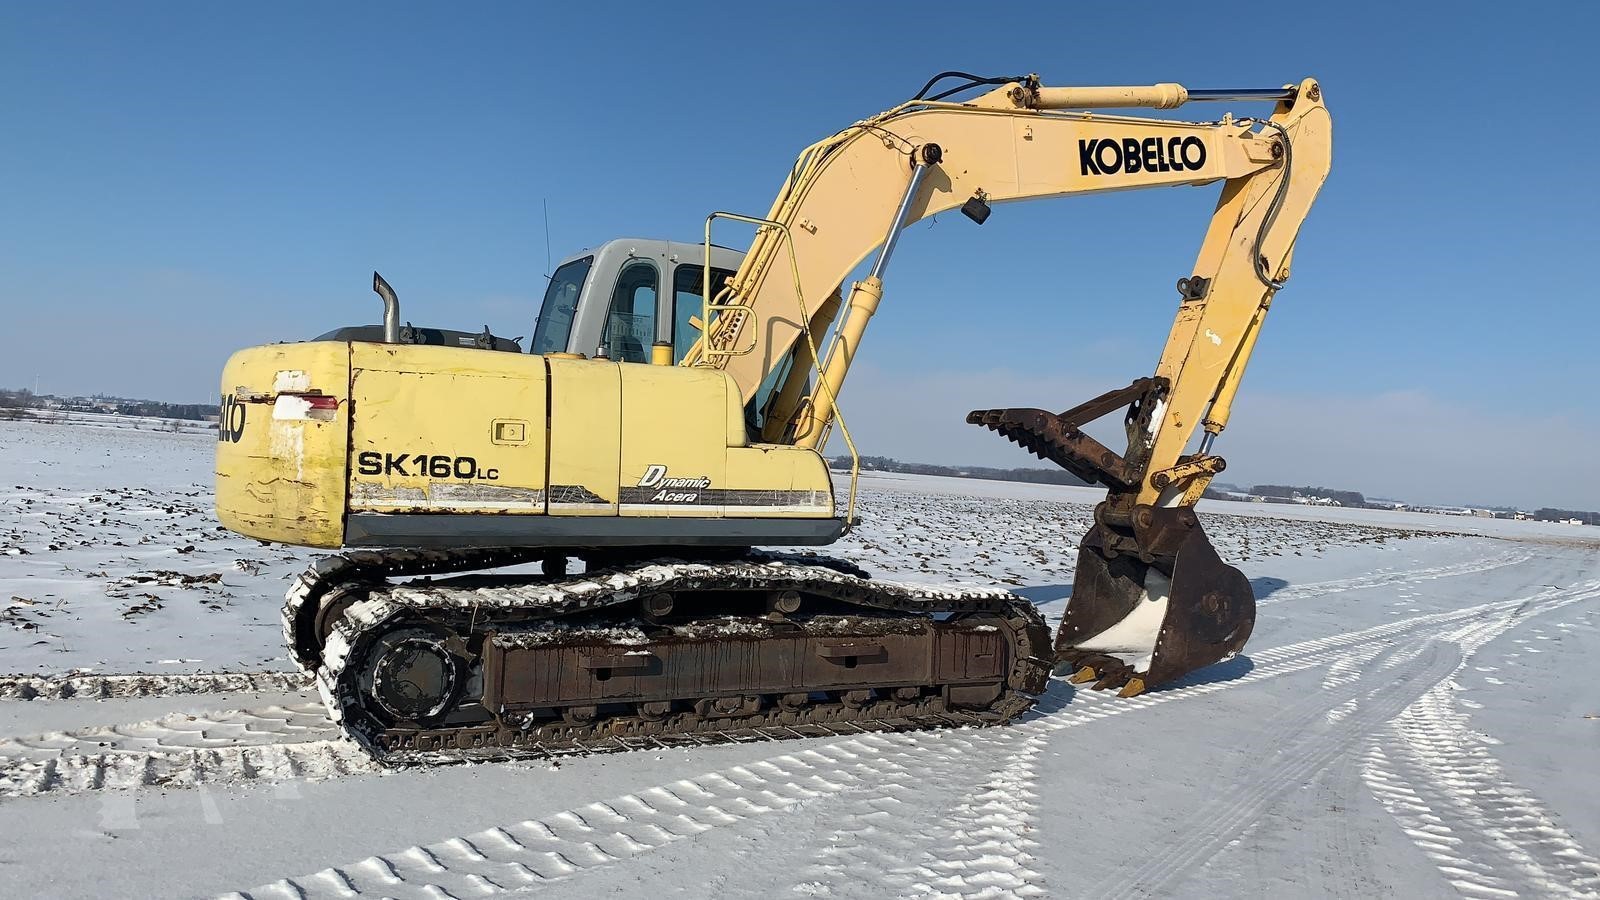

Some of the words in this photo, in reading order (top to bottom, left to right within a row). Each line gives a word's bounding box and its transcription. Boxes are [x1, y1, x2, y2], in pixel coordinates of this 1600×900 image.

[1078, 136, 1207, 176] KOBELCO
[637, 464, 711, 490] Dynamic
[651, 489, 698, 502] Acera
